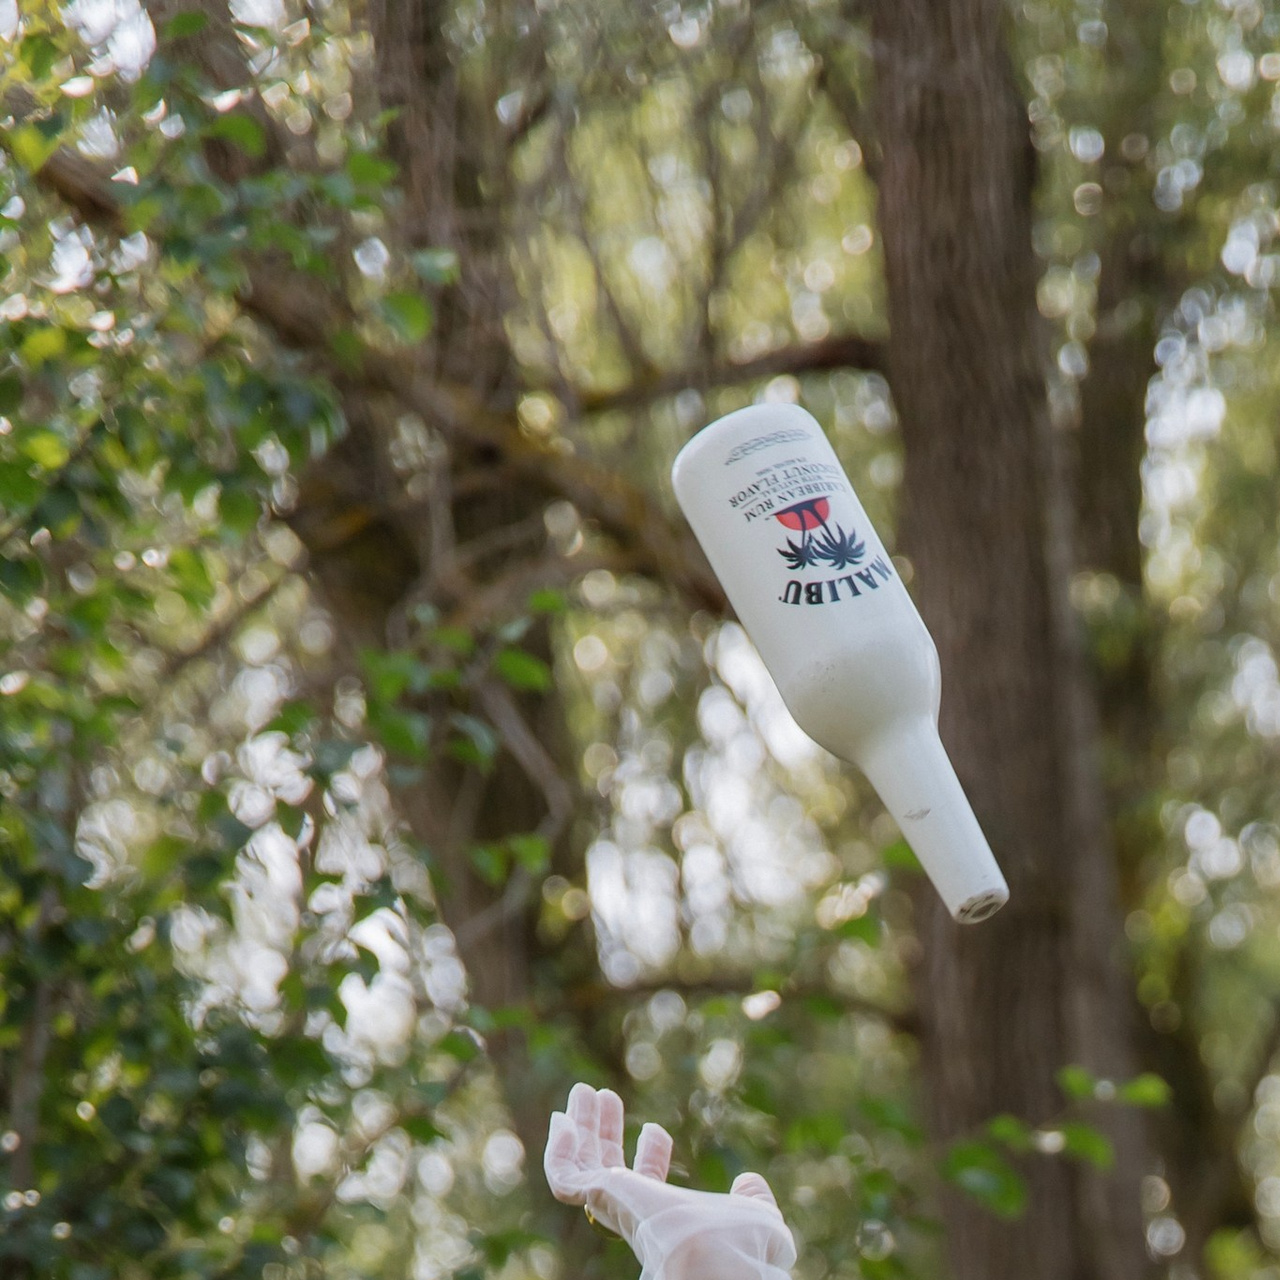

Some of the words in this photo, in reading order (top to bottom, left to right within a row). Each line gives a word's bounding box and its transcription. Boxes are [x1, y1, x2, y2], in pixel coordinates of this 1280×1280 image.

[728, 474, 779, 508] FLAVOR
[777, 481, 848, 504] CARIBBEAN
[743, 498, 775, 522] RUM
[779, 555, 893, 606] MALIBU
